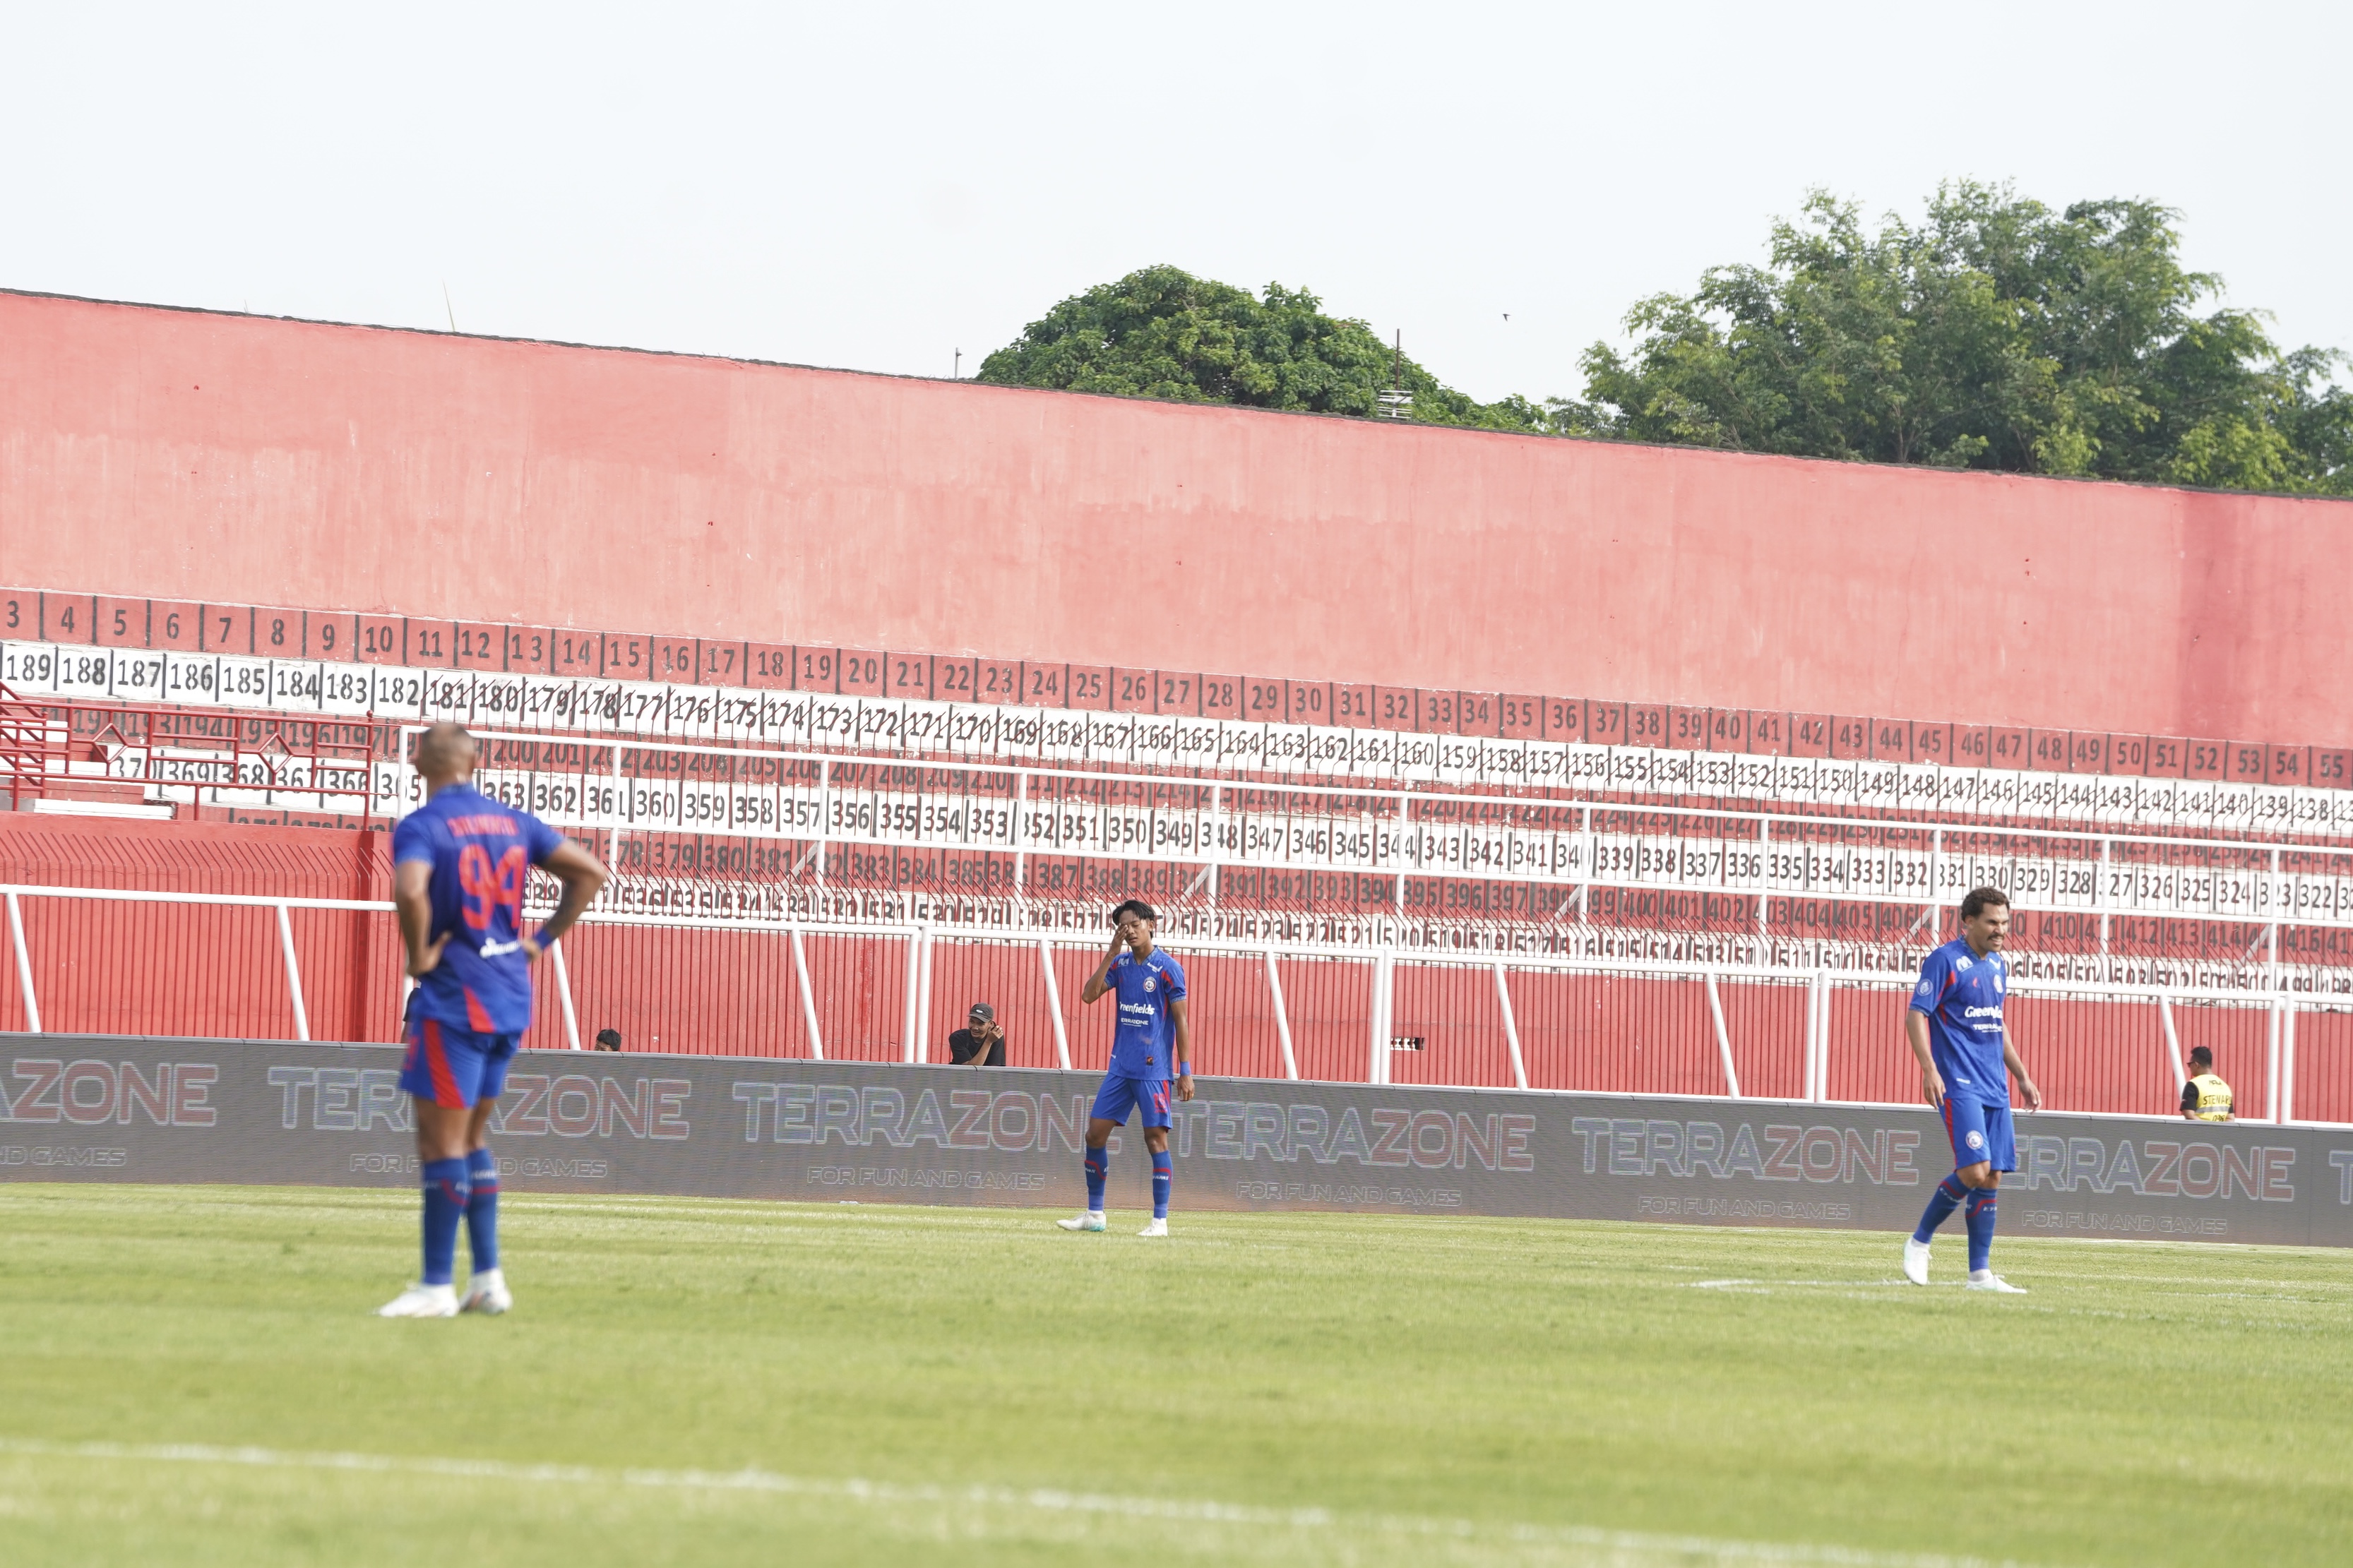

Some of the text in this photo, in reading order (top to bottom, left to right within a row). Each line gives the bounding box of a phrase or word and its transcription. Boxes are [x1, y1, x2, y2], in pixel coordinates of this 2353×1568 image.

[6, 601, 2344, 778] 3 4 5 6 7 8 9 10 11 12 13 14 15 16 17 18 19 20 21 22 23 24 25 26 27 28 29 30 31 32 33 34 35 36 37 38 39 40 41 42 43 44 45 46 47 48 49 50 51 52 53 54 55
[6, 654, 2289, 818] 189 188 187 186 185 184 183 182 181 179 177 175 173 171 169 167 165 163 161 159 157 155 153 151 149 147 145 143 141 139
[536, 783, 2332, 909] 362 360 359 358 357 356 354 353 351 350 347 346 345 343 342 339 338 337 336 335 333 332 329 326 325 324 322
[459, 844, 528, 930] 94
[1225, 871, 2198, 945] 391 392 395 397 401 402 404 413
[1119, 1001, 1155, 1015] reenfields
[1121, 1017, 1149, 1026] ERRAZONE
[268, 1067, 692, 1139] TERZONE
[30, 1147, 128, 1166] GAMES
[1170, 1099, 1536, 1172] TERRAZONE
[1572, 1116, 1922, 1186] TERRAZONE
[349, 1154, 403, 1173] FOR
[520, 1158, 609, 1178] GAMES
[807, 1166, 1045, 1190] FOR FUN AND GAMES
[1236, 1180, 1463, 1207] FOR FUN AND GAMES
[1637, 1196, 1858, 1220] FOR FUN AND GAMES
[2021, 1209, 2227, 1235] FOR FUN AND GAMES
